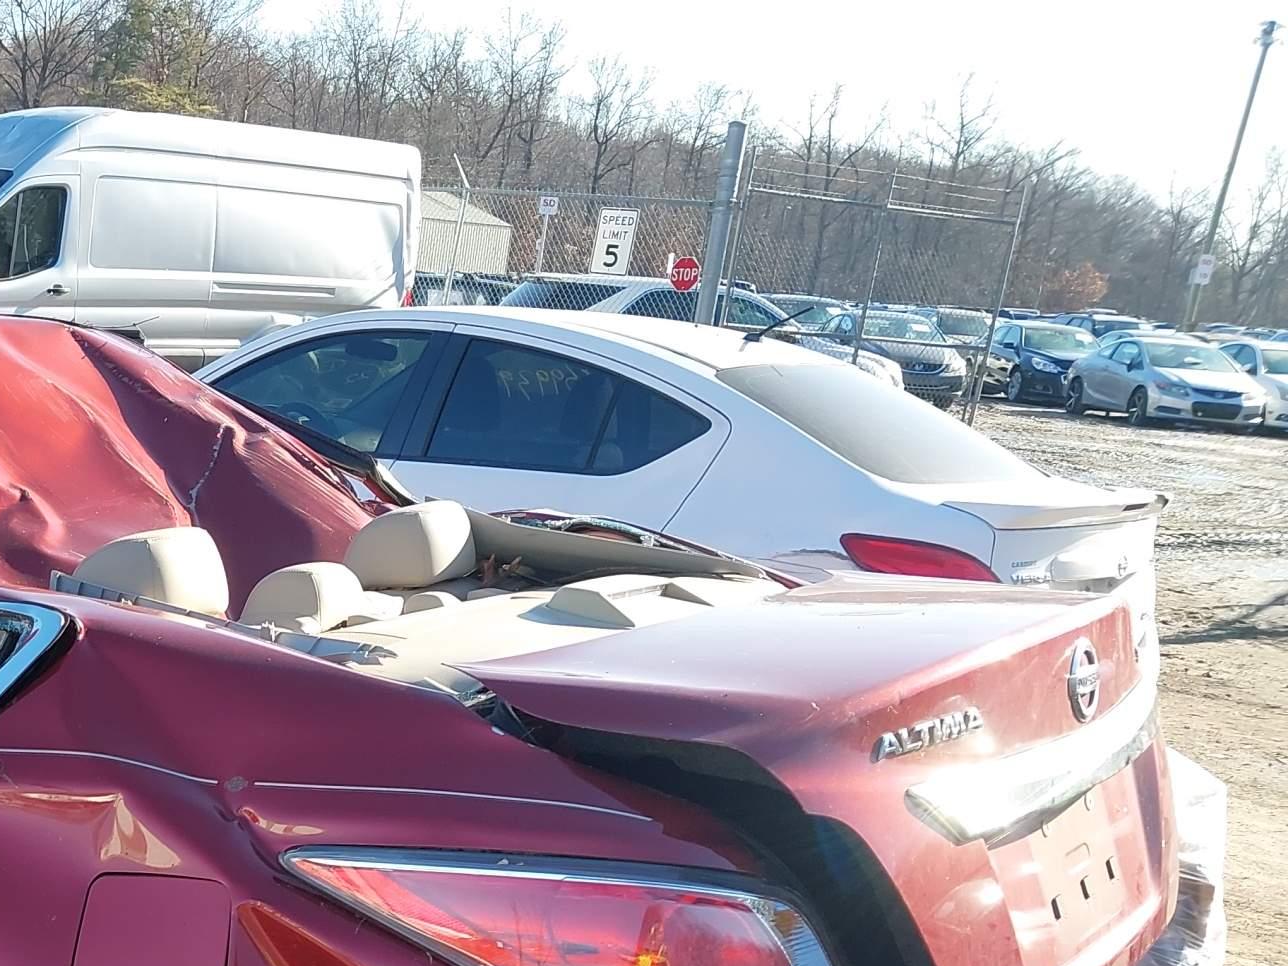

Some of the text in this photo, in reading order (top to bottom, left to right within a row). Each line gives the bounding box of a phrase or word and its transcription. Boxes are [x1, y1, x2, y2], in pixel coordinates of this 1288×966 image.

[601, 214, 635, 227] SPEED
[601, 229, 629, 241] LIMIT
[602, 243, 620, 268] 5
[671, 267, 698, 282] STOP
[870, 706, 984, 763] ALTIMA
